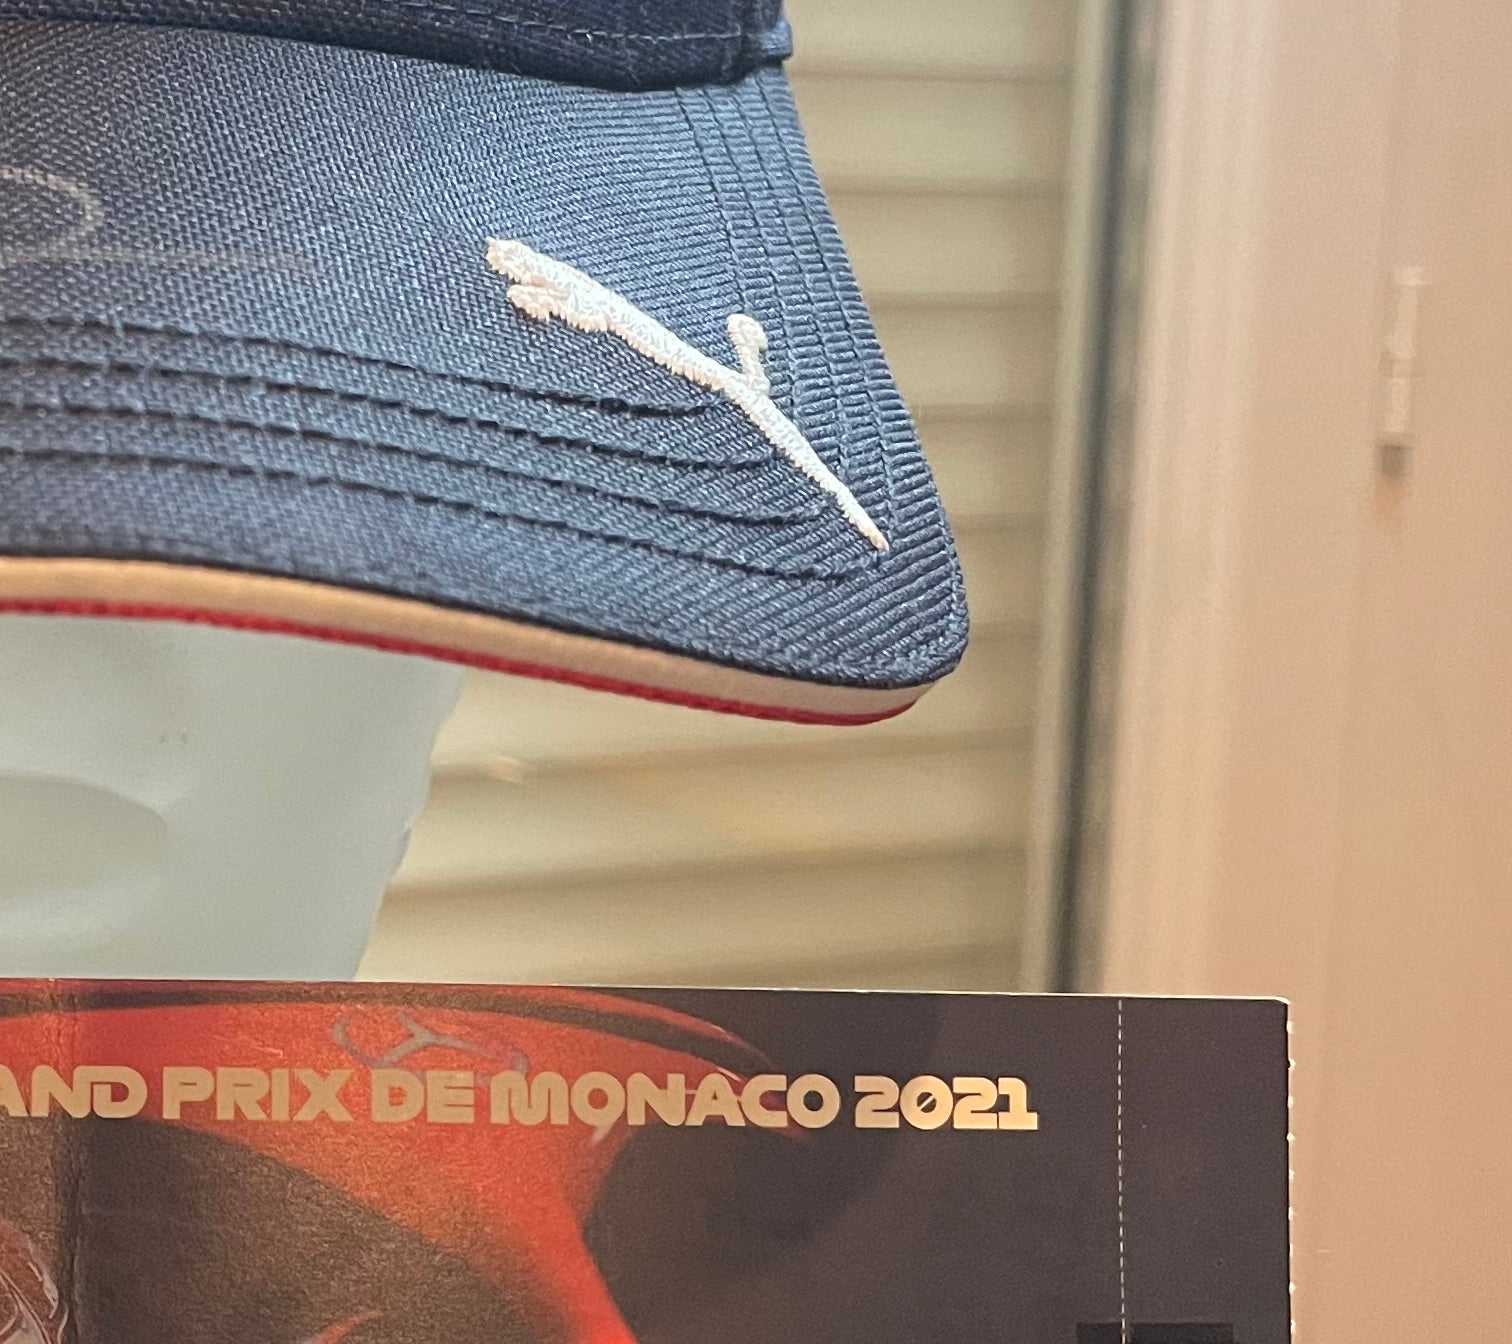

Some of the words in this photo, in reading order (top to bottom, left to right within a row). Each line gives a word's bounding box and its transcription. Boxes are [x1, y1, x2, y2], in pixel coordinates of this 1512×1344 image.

[163, 1067, 353, 1123] PRIX
[370, 1069, 475, 1123] DE
[490, 1072, 841, 1130] MONACO
[854, 1074, 1040, 1131] 2021
